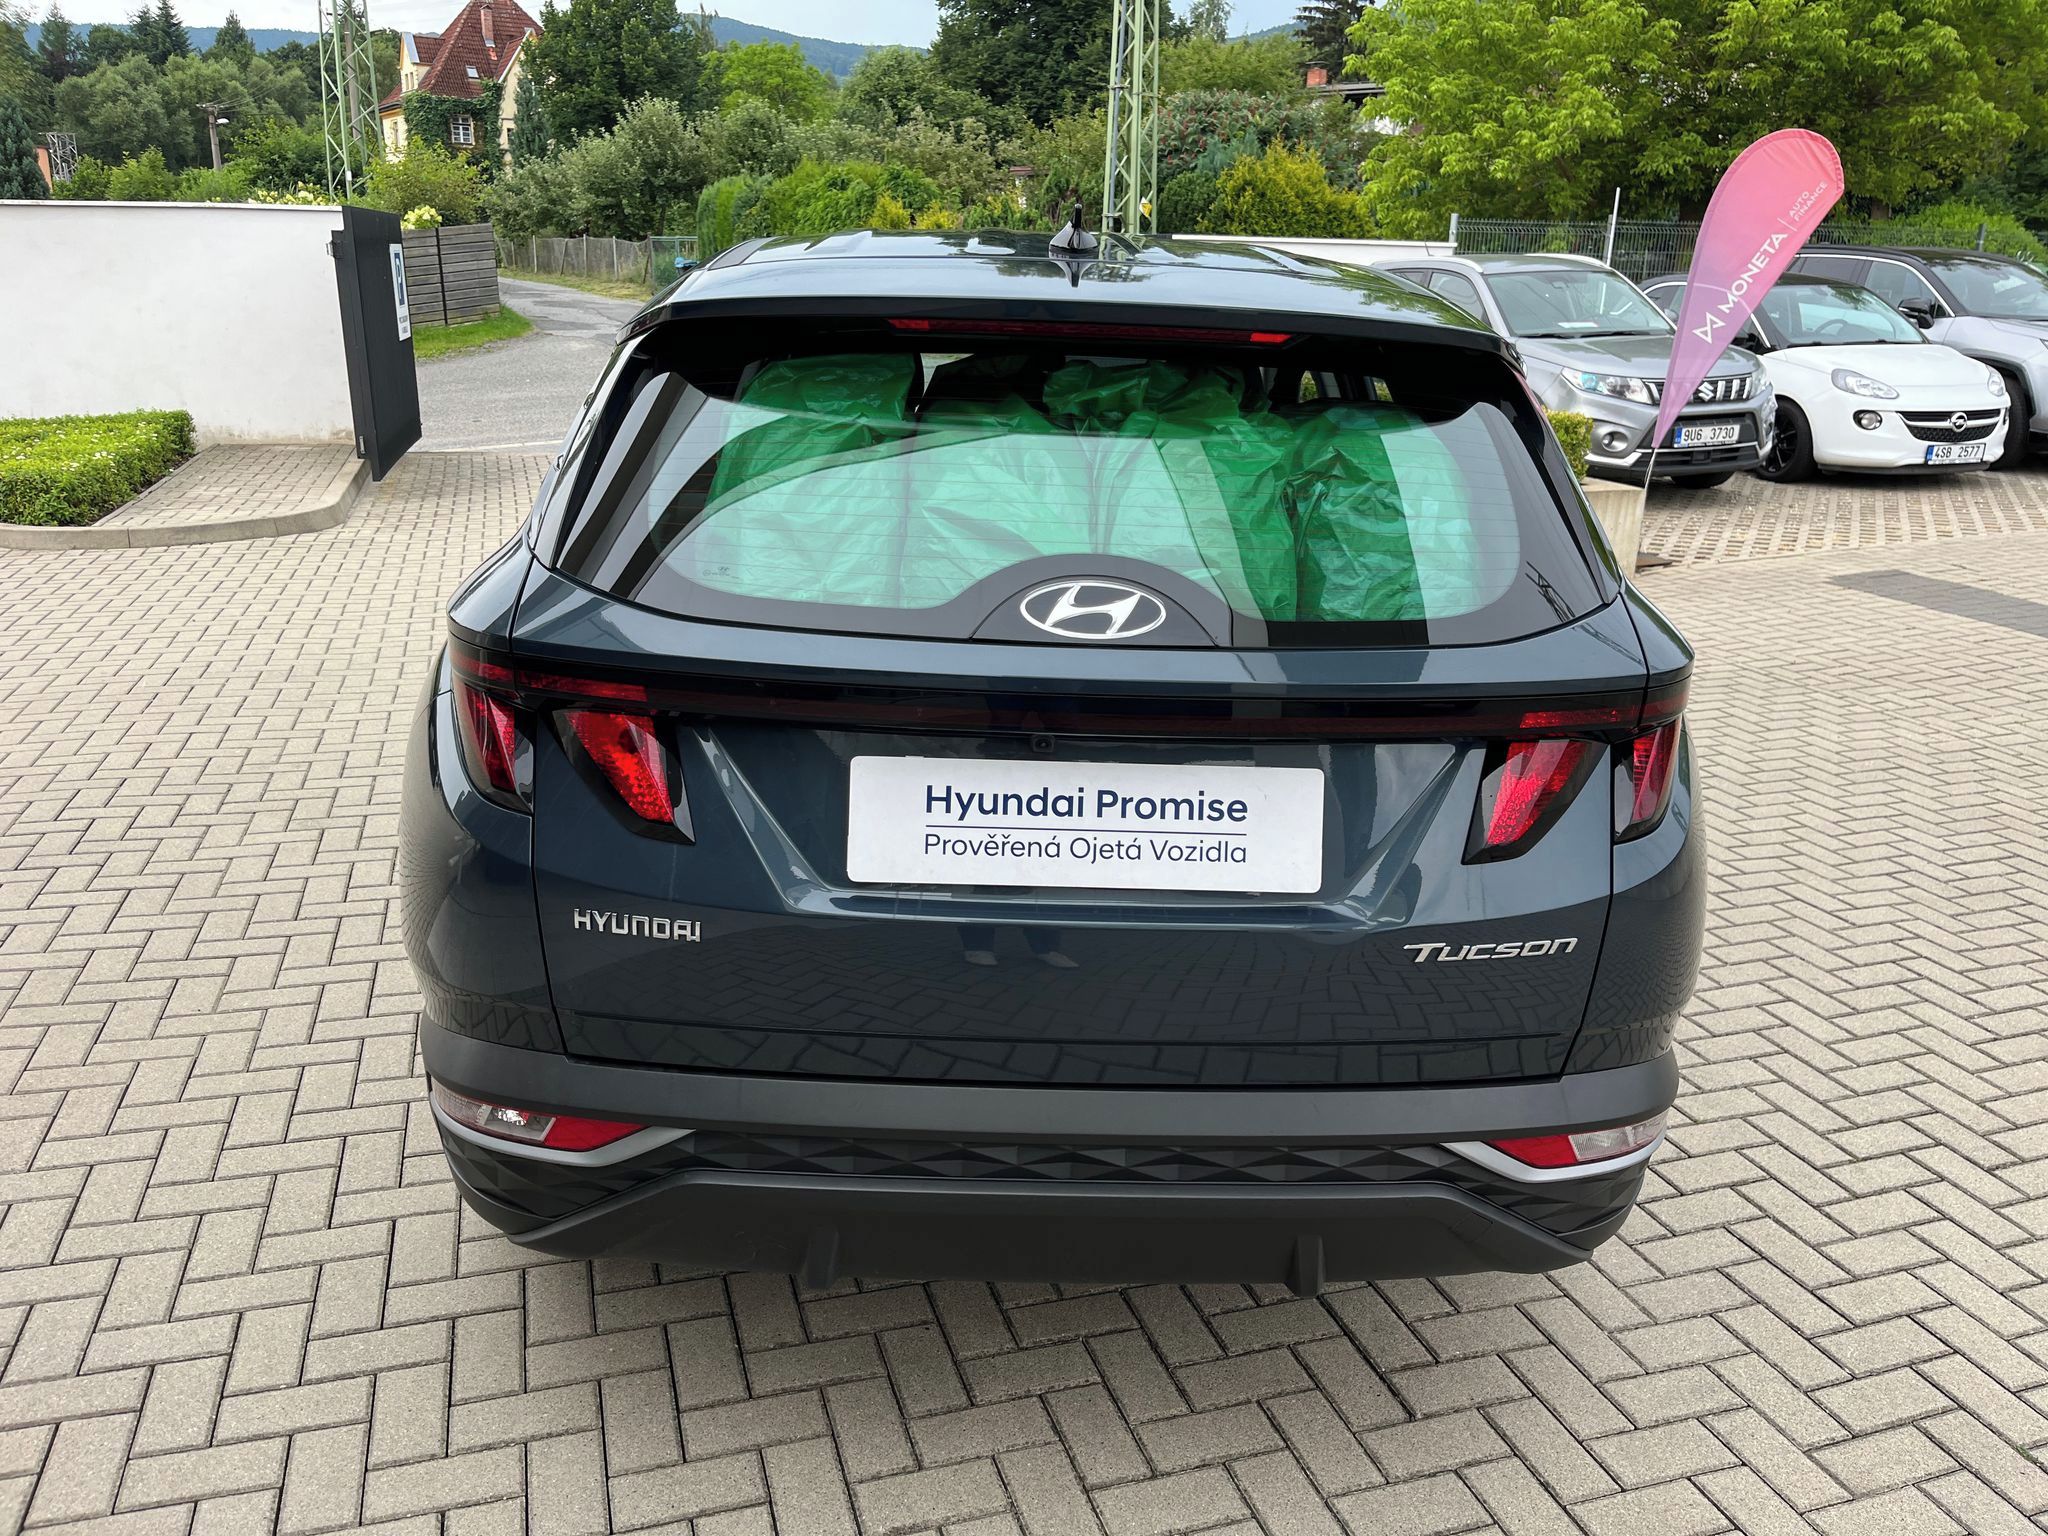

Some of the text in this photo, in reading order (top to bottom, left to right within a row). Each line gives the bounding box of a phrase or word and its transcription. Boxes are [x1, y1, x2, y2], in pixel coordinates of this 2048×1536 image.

[1789, 191, 1809, 218] AUTO
[1794, 182, 1828, 221] FINANCE
[395, 258, 402, 300] P
[1717, 233, 1788, 313] MONETA
[1683, 427, 1735, 442] 9U6 3730
[1935, 446, 1980, 458] 4SB 2577
[925, 785, 1248, 822] Hyundai Promise
[924, 834, 1247, 865] Prověřená Ojetá Vozidla
[573, 908, 701, 942] HYUNDAI
